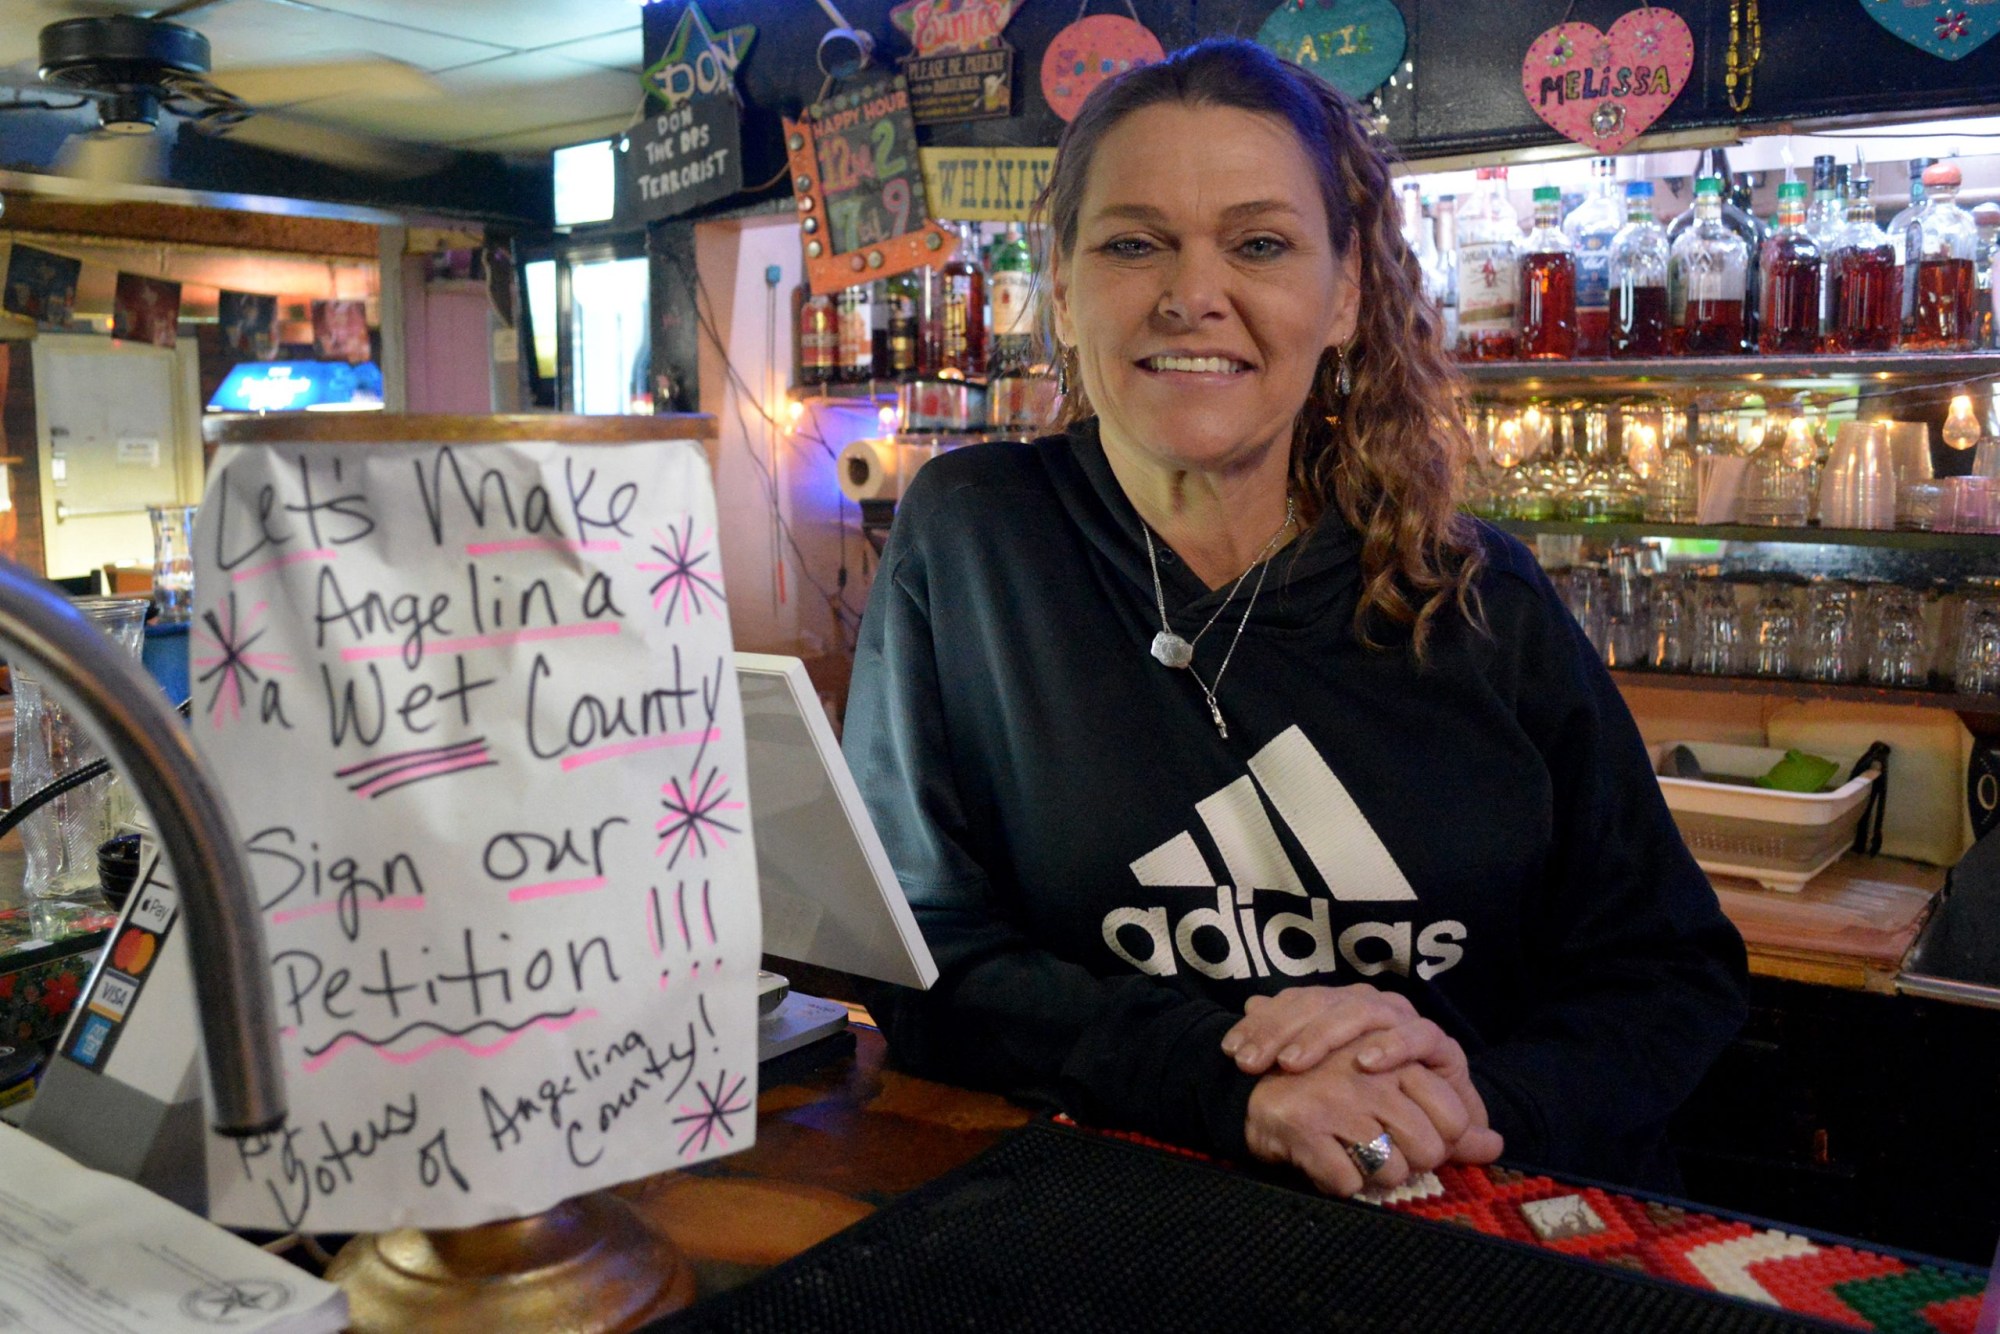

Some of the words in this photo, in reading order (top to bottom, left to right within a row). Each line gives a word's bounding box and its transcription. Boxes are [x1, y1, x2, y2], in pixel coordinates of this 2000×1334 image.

[654, 29, 740, 102] DON
[657, 105, 693, 136] DON
[813, 110, 860, 138] HAPPY
[863, 91, 907, 118] HOUR
[637, 148, 729, 201] TERRORIST
[645, 137, 675, 165] THE
[871, 119, 907, 181] 2
[882, 178, 911, 238] 9
[216, 454, 376, 571] Let's
[413, 446, 638, 547] Make
[315, 562, 625, 670] Angelina
[260, 678, 294, 730] a
[321, 653, 500, 748] Wet
[526, 644, 724, 778] County
[246, 826, 426, 942] Sign
[482, 815, 630, 881] our
[148, 898, 170, 923] Pay
[1101, 884, 1468, 981] adidas
[101, 982, 129, 1009] VISA
[418, 1129, 470, 1193] of
[481, 1029, 647, 1152] Angelina
